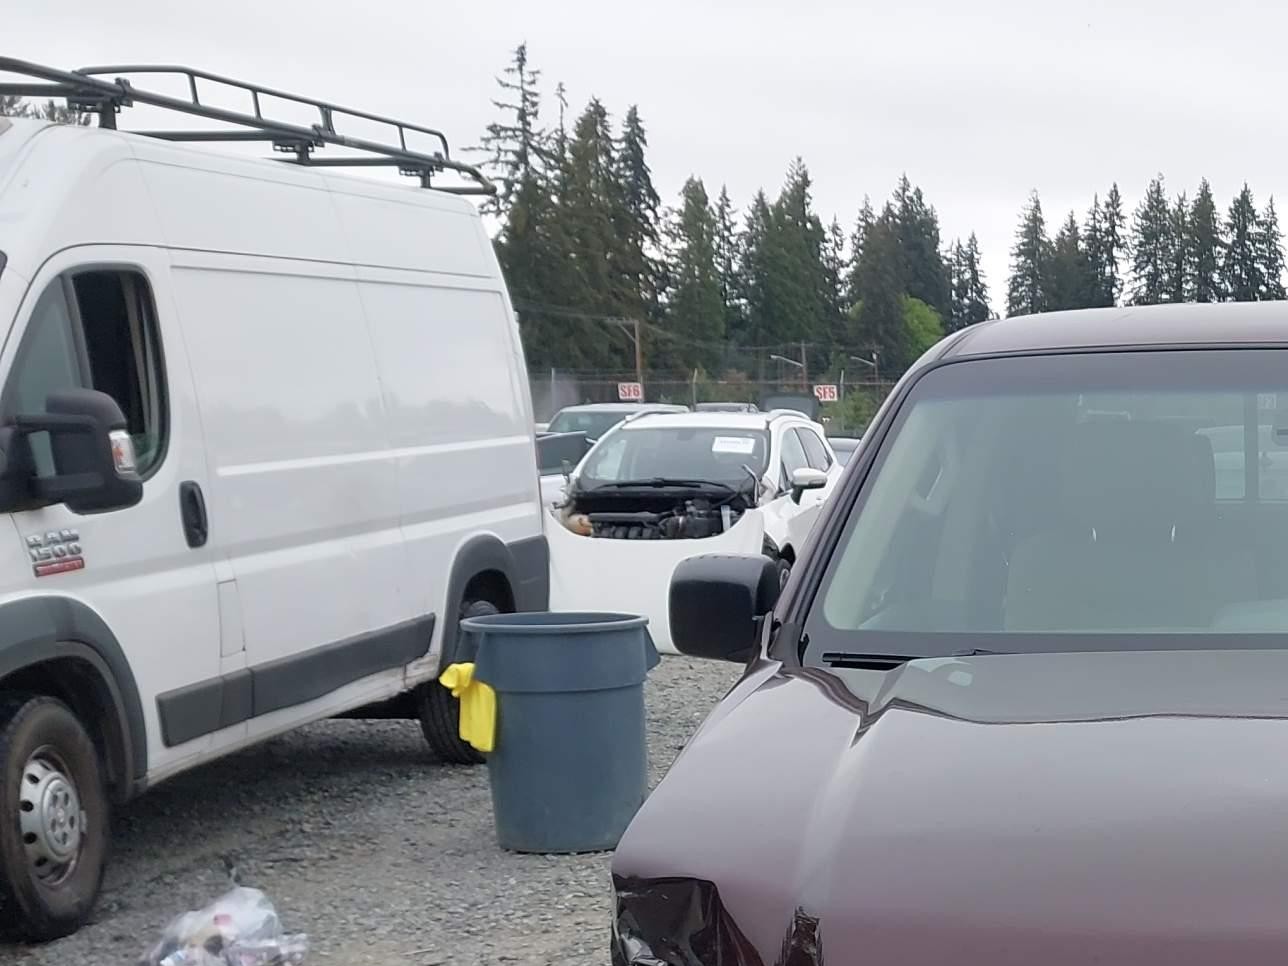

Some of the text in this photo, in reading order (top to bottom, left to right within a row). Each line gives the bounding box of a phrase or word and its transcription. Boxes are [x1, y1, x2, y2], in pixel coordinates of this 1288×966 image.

[620, 385, 640, 398] SF6
[816, 386, 835, 399] SF5
[25, 528, 80, 548] RAM
[28, 542, 83, 562] 1500
